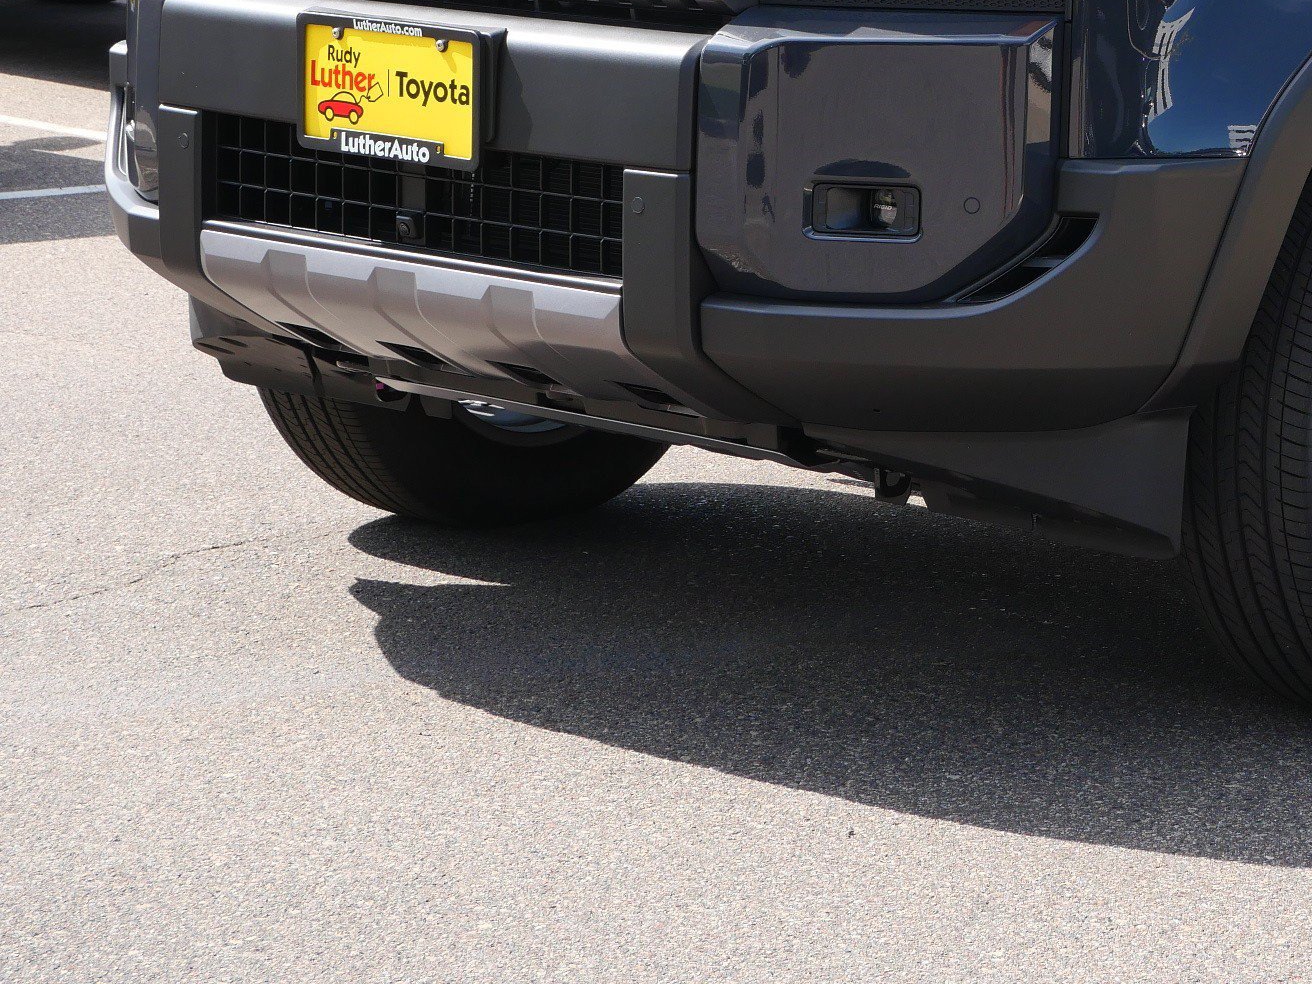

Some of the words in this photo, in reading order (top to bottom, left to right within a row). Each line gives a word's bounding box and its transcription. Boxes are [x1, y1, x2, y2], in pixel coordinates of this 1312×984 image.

[353, 18, 423, 37] LutherAuto.com
[327, 44, 361, 69] Rudy
[310, 59, 376, 93] Luther
[395, 70, 470, 107] Toyota
[340, 132, 430, 163] LutherAuto
[873, 203, 893, 211] RIGID
